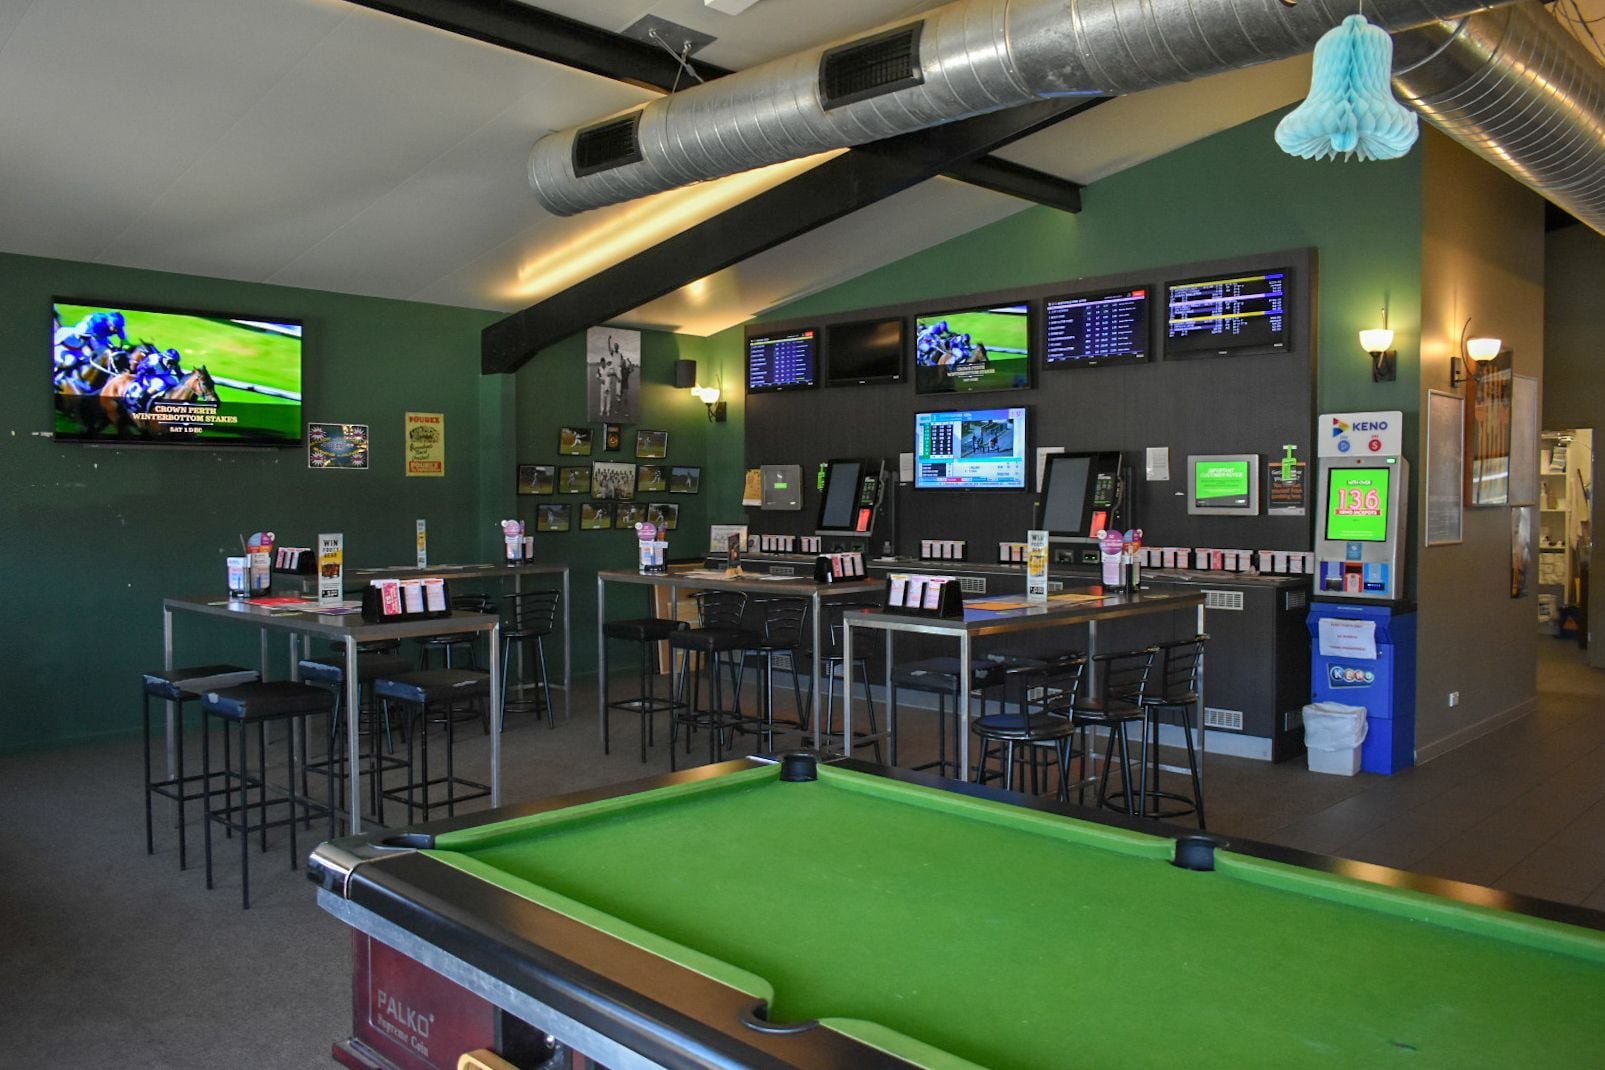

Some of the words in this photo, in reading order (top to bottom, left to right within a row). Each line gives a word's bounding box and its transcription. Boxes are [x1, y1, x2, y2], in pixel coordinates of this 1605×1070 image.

[155, 405, 187, 414] CROWN
[188, 406, 217, 415] PERTH
[132, 413, 204, 422] WINTERBOTTOM
[205, 415, 238, 423] STAKES
[1352, 421, 1388, 431] KENO
[1339, 488, 1380, 510] 136
[1332, 667, 1374, 682] KENO
